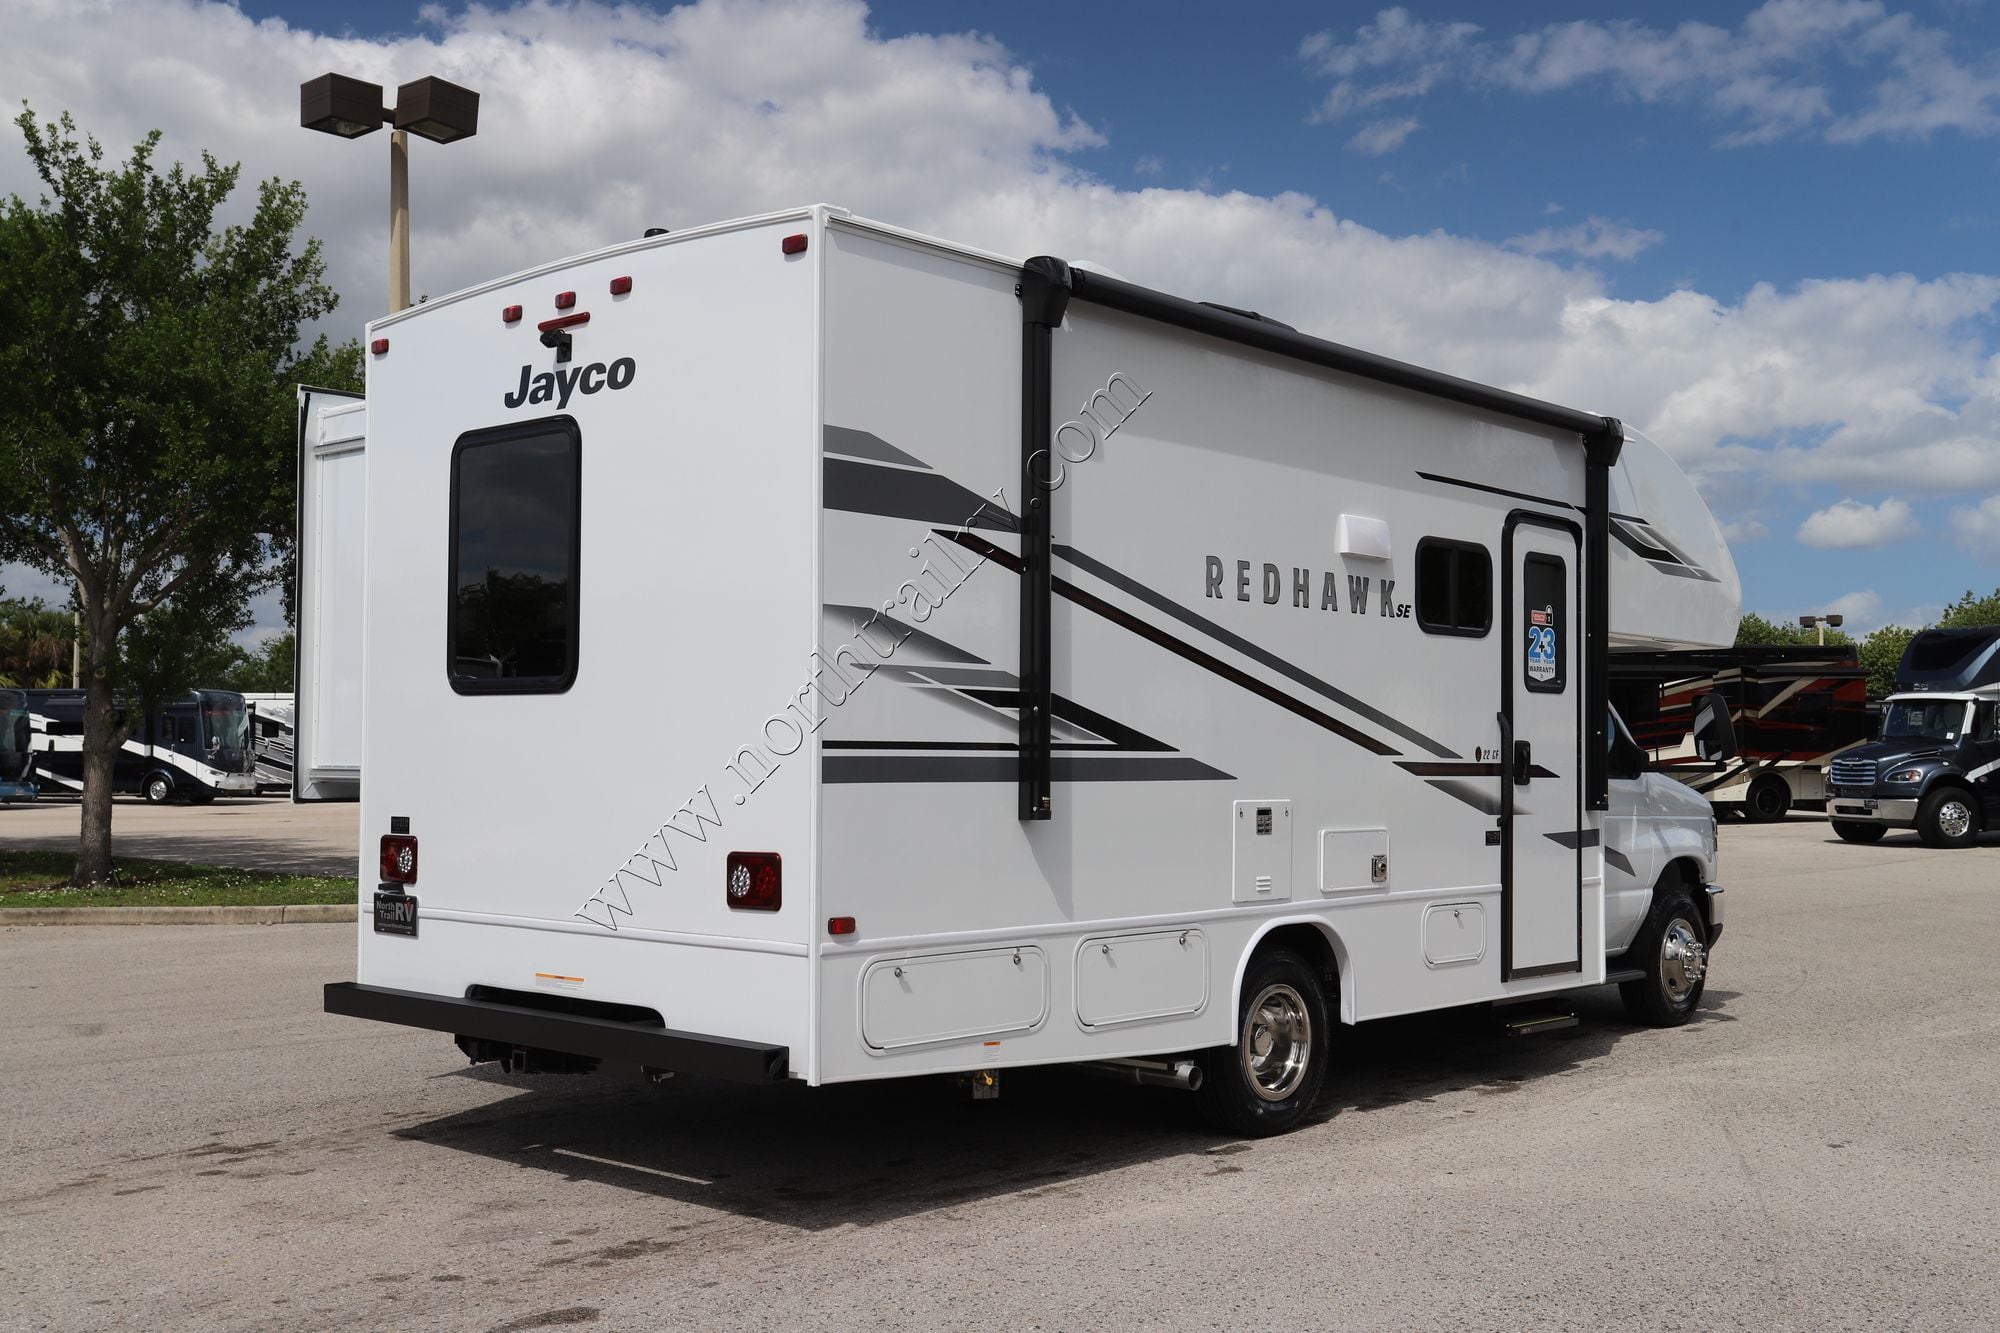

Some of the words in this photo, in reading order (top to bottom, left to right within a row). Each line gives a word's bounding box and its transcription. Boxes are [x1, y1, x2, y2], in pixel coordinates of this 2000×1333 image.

[504, 357, 636, 410] Jayco
[1205, 555, 1395, 618] REDHAWK
[1396, 604, 1411, 619] SE
[1529, 665, 1555, 674] WARRANTY
[376, 900, 395, 911] North
[395, 902, 414, 922] RV
[380, 910, 395, 921] Trail
